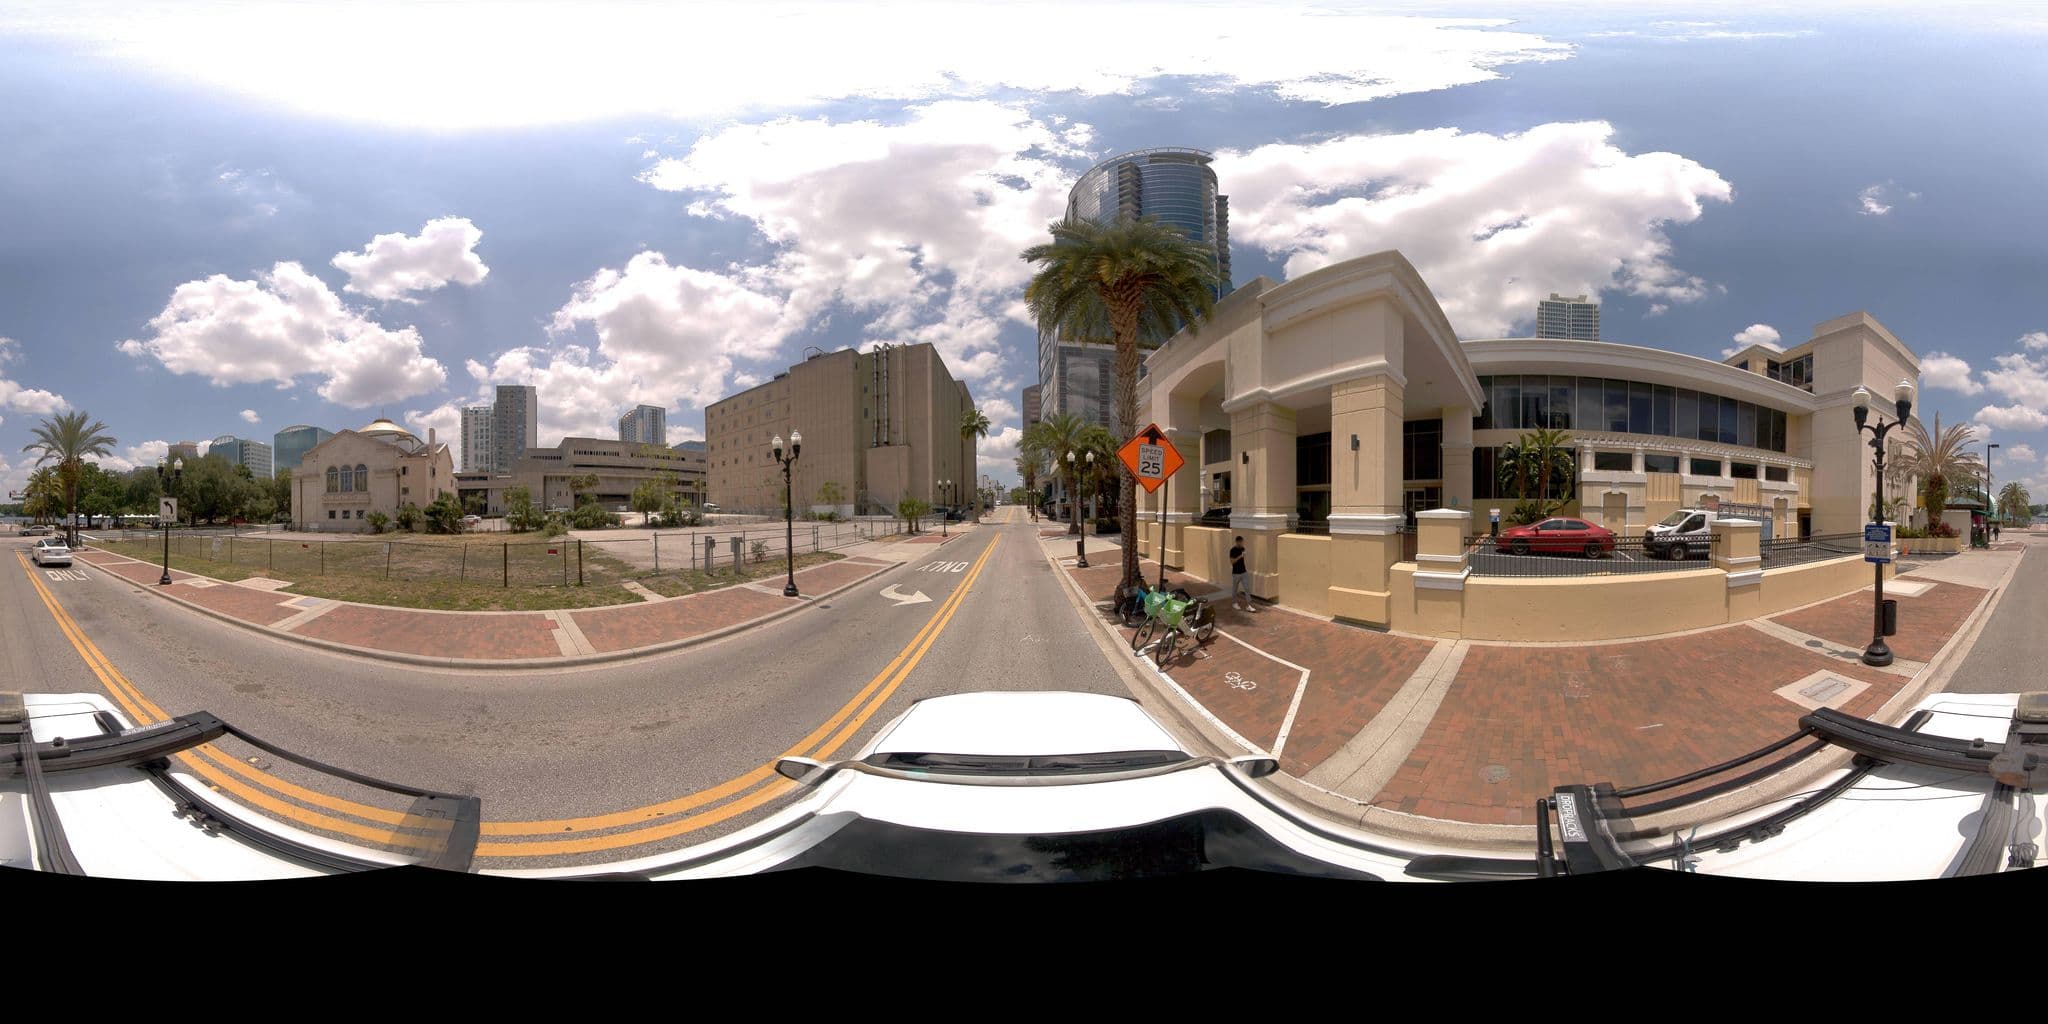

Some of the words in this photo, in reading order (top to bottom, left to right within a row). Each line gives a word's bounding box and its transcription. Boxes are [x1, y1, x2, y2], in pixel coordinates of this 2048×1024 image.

[1141, 461, 1161, 475] 25
[914, 560, 969, 573] ONLY
[45, 569, 92, 582] ONLY
